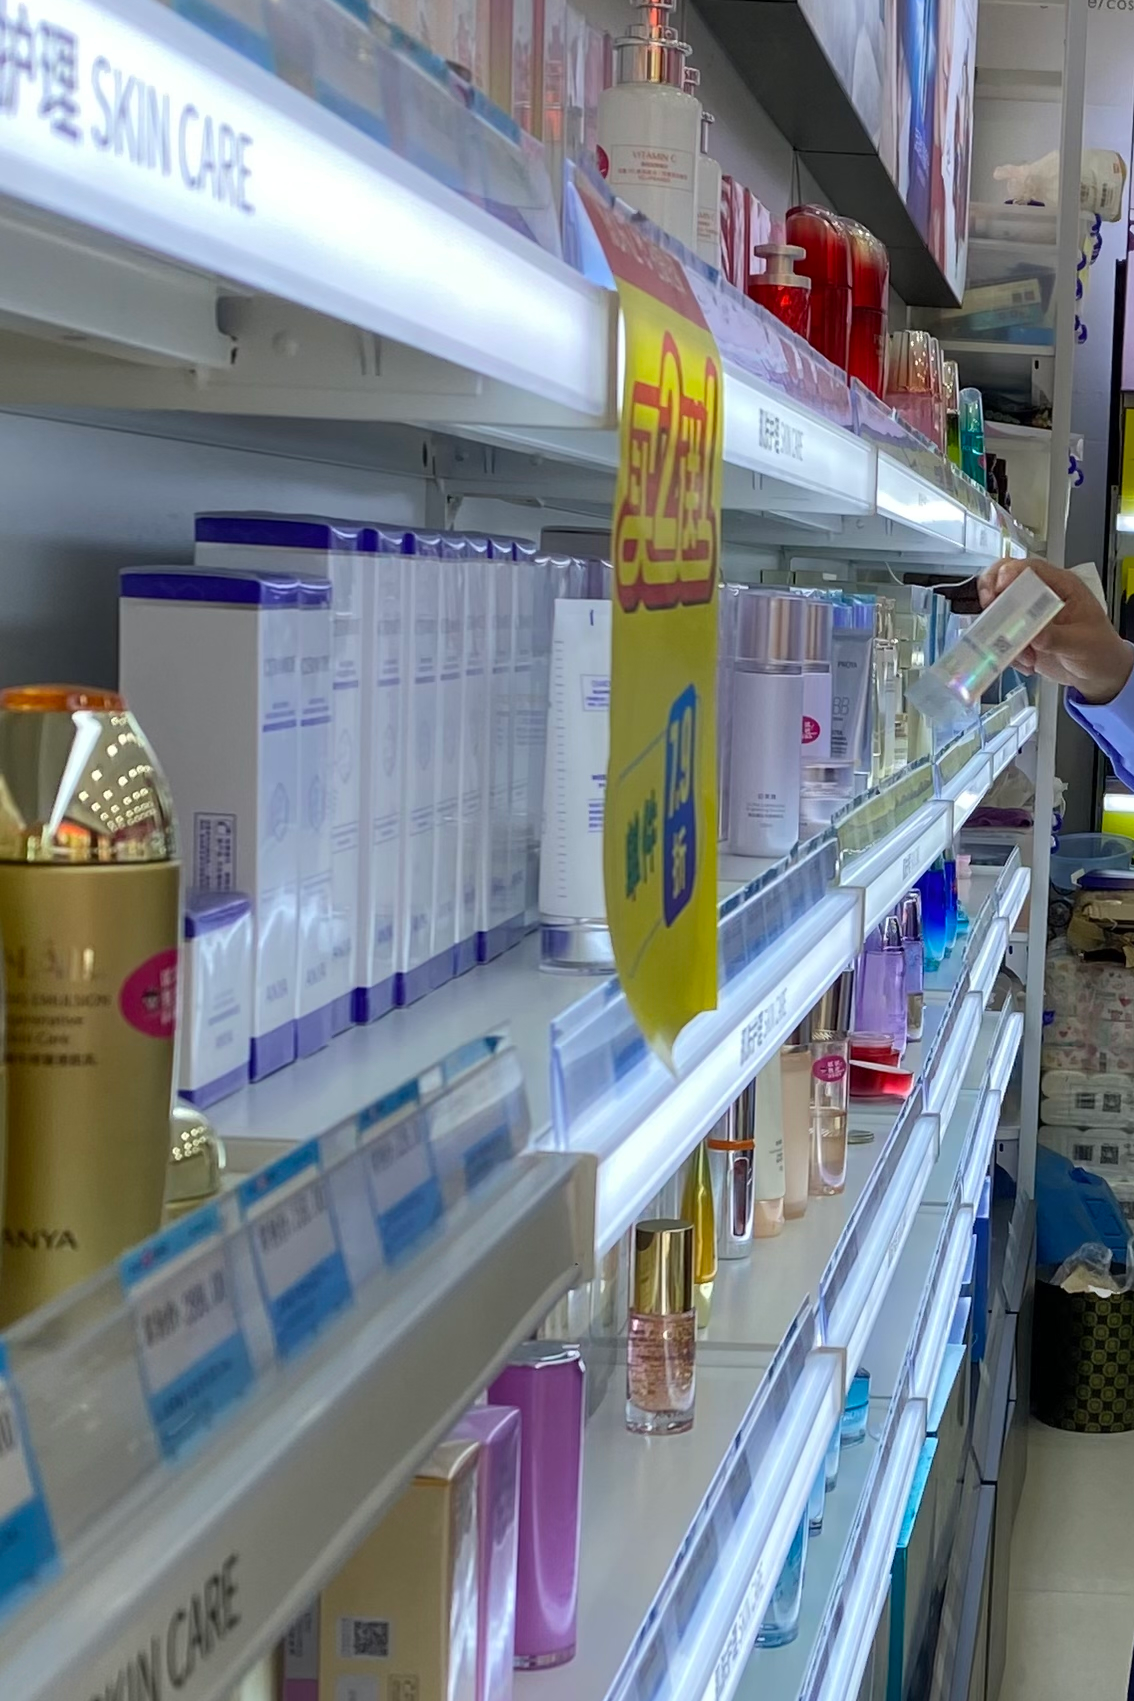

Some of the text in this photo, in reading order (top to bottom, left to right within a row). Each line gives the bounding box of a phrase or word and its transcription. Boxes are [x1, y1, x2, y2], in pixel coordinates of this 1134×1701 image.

[91, 55, 171, 177] SKIN
[179, 103, 255, 215] CARE
[167, 1554, 242, 1690] CARE
